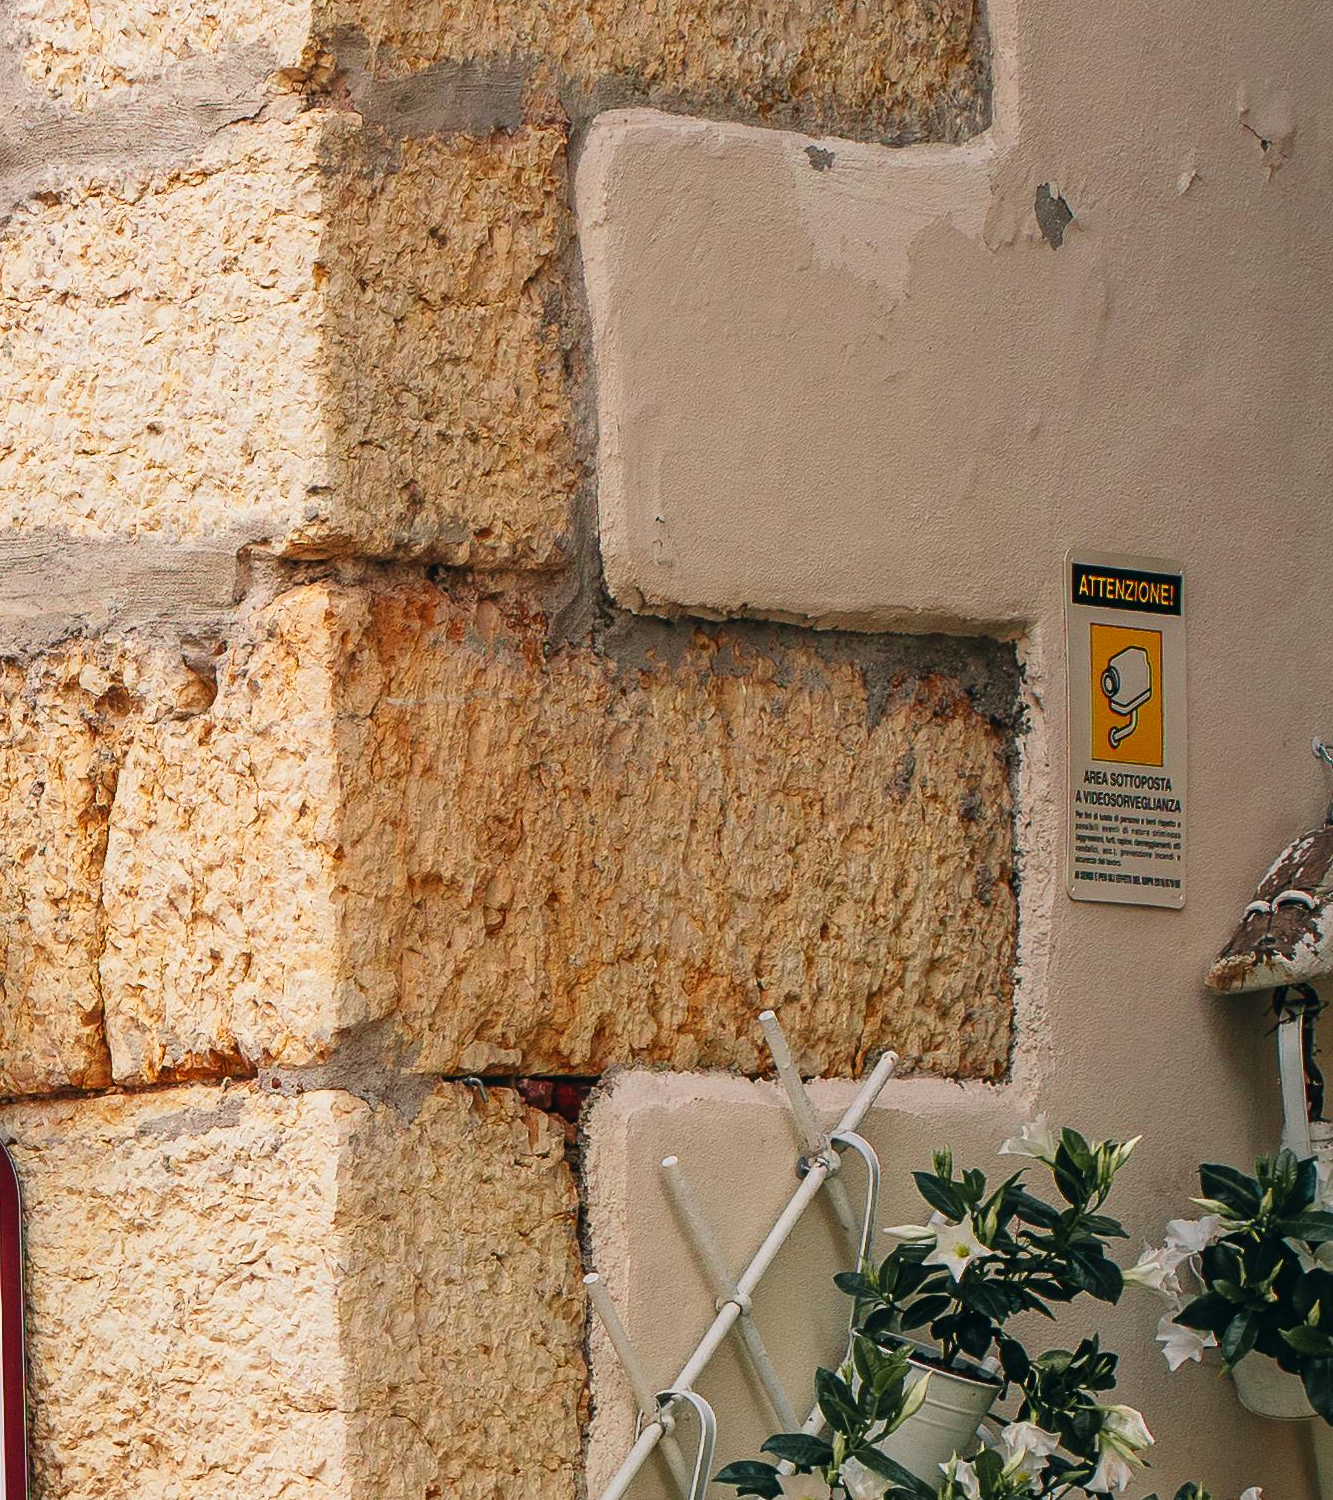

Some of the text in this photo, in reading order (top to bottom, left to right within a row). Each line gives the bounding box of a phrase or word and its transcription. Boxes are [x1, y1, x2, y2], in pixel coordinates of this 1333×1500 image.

[1078, 574, 1174, 605] ATTENZIONE!
[1083, 770, 1171, 791] AREA SOTTOPOSTA
[1075, 790, 1181, 811] A VIDEOSORVEGLIANZA
